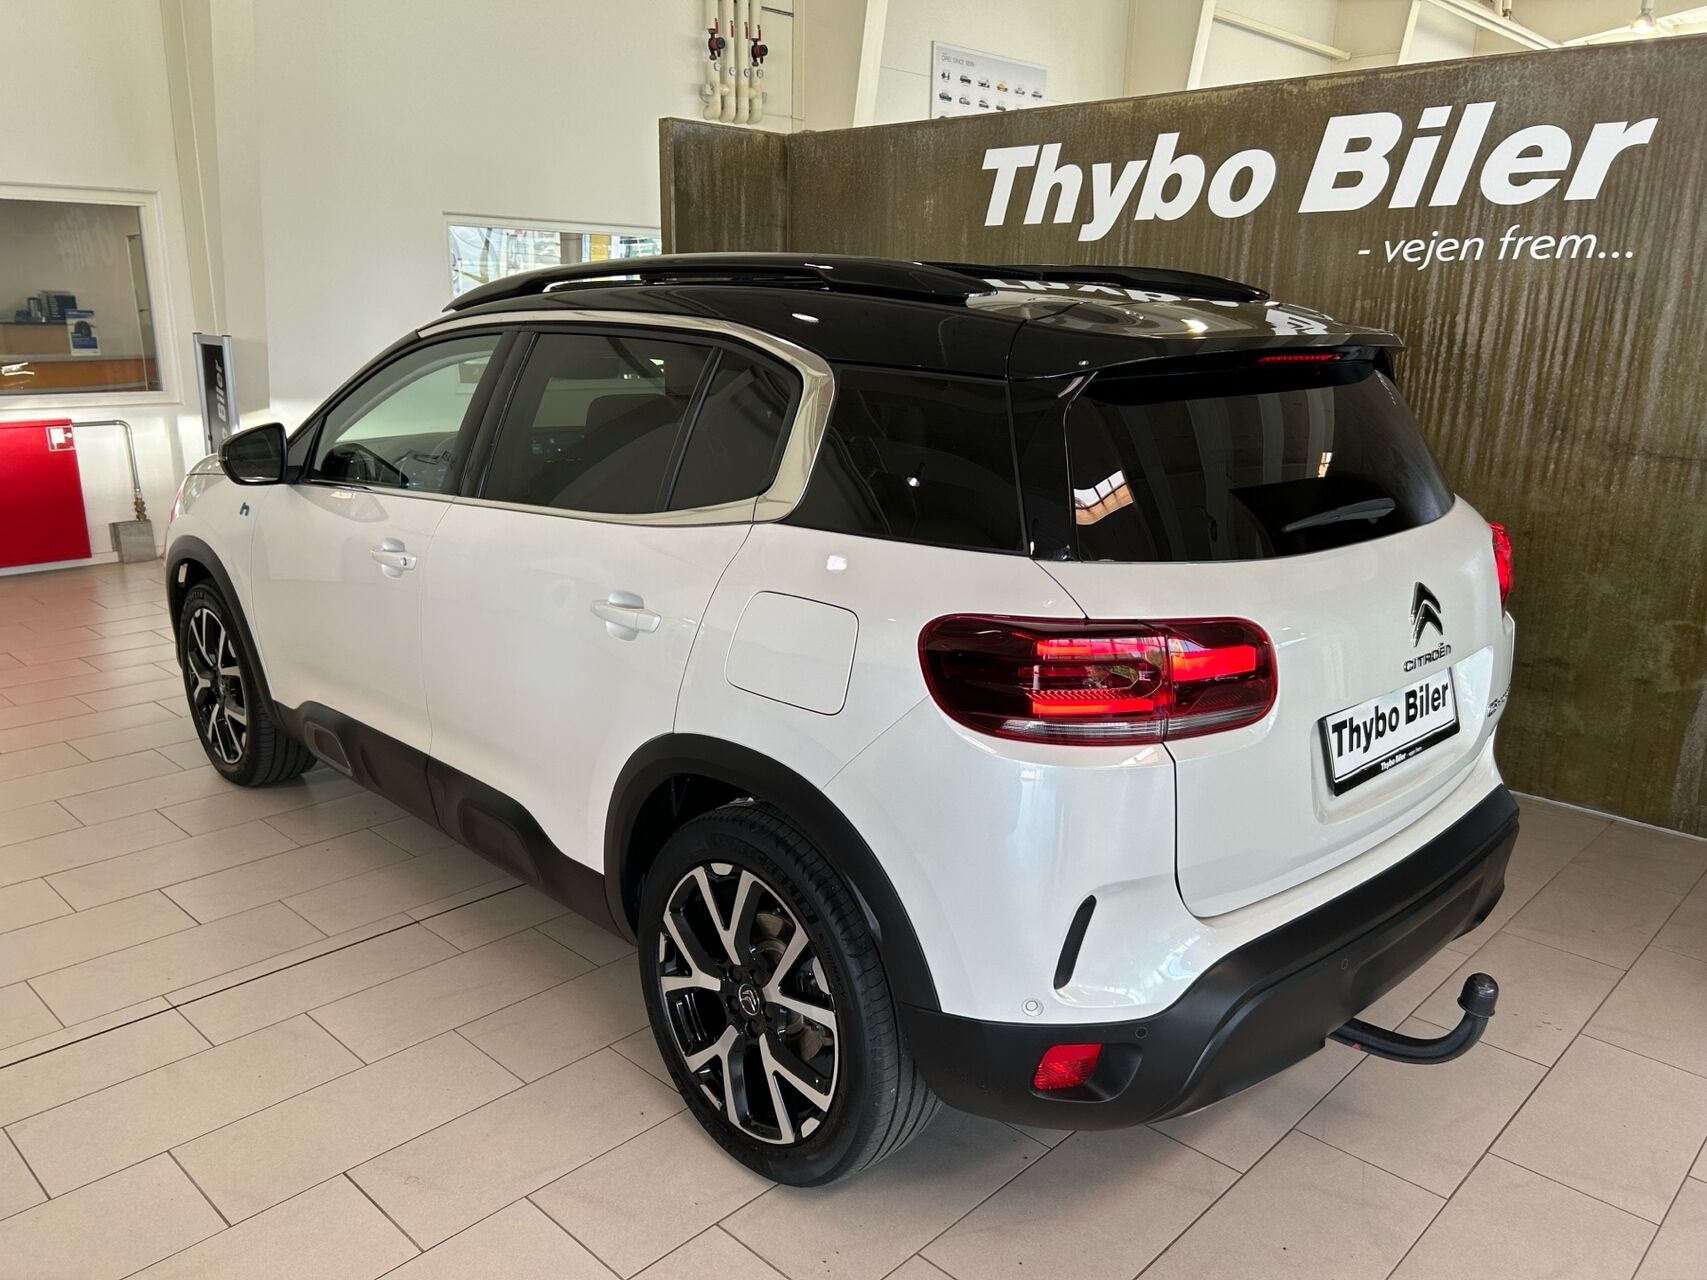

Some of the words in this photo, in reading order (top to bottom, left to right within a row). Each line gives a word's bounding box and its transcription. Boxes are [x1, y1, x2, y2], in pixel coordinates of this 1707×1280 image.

[981, 131, 1277, 242] Thybo
[1297, 101, 1660, 214] Biler
[1383, 230, 1485, 271] vejen
[1498, 224, 1634, 262] frem...
[214, 359, 228, 422] Biler
[1331, 704, 1400, 758] Thybo
[1404, 682, 1449, 726] Biler
